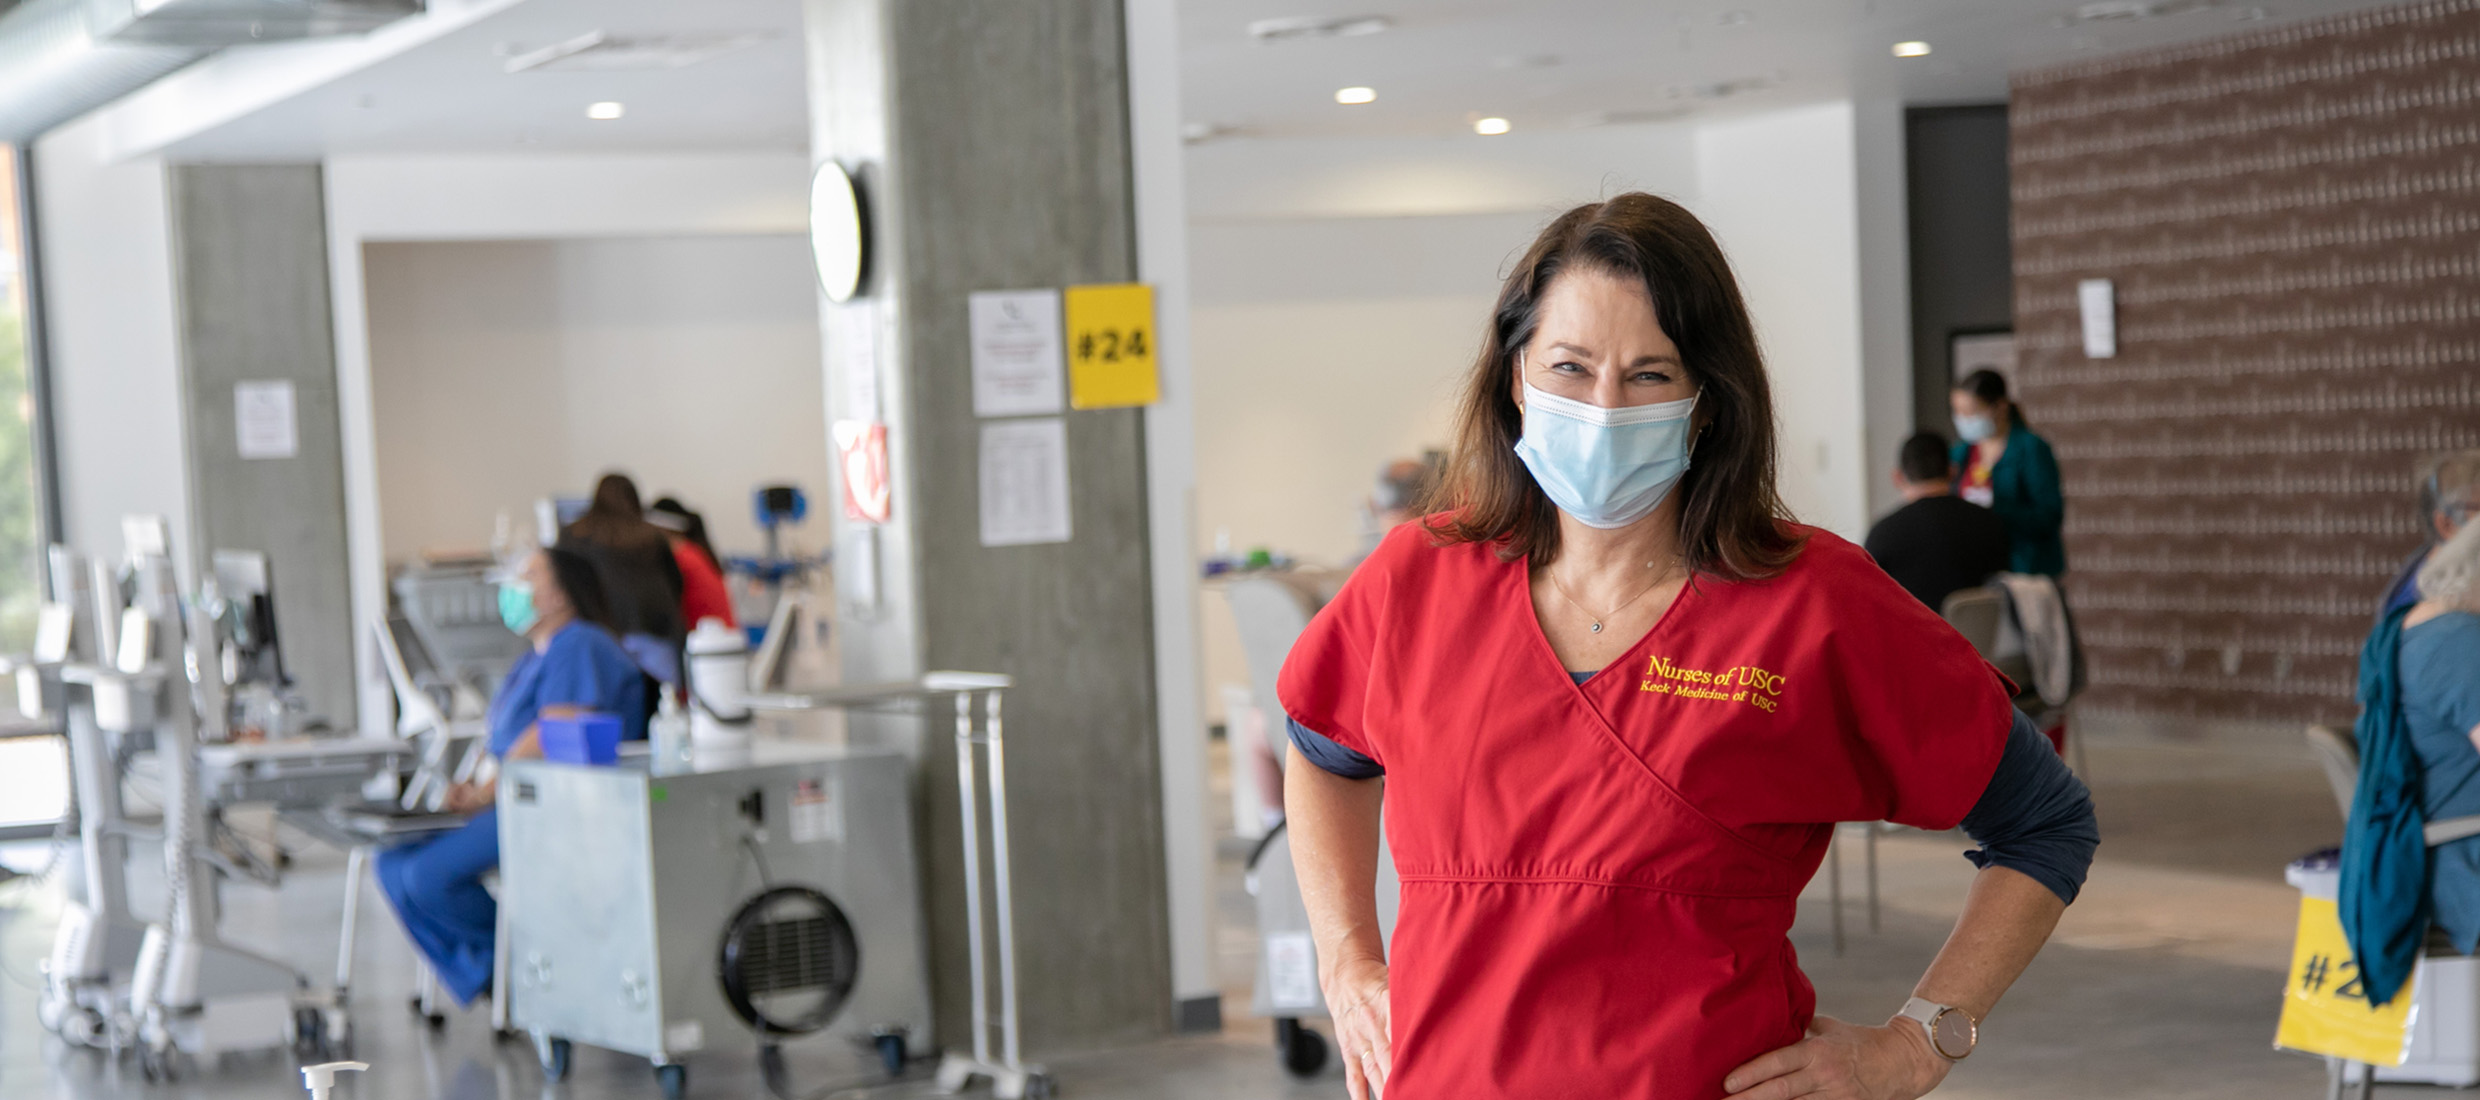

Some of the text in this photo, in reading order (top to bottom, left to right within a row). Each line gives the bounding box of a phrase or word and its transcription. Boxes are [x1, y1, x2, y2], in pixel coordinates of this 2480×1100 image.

[1077, 329, 1147, 363] #24
[1646, 655, 1785, 696] Nurses of USC
[1640, 680, 1777, 713] Keck Medicine of USC
[2302, 954, 2366, 999] #2
